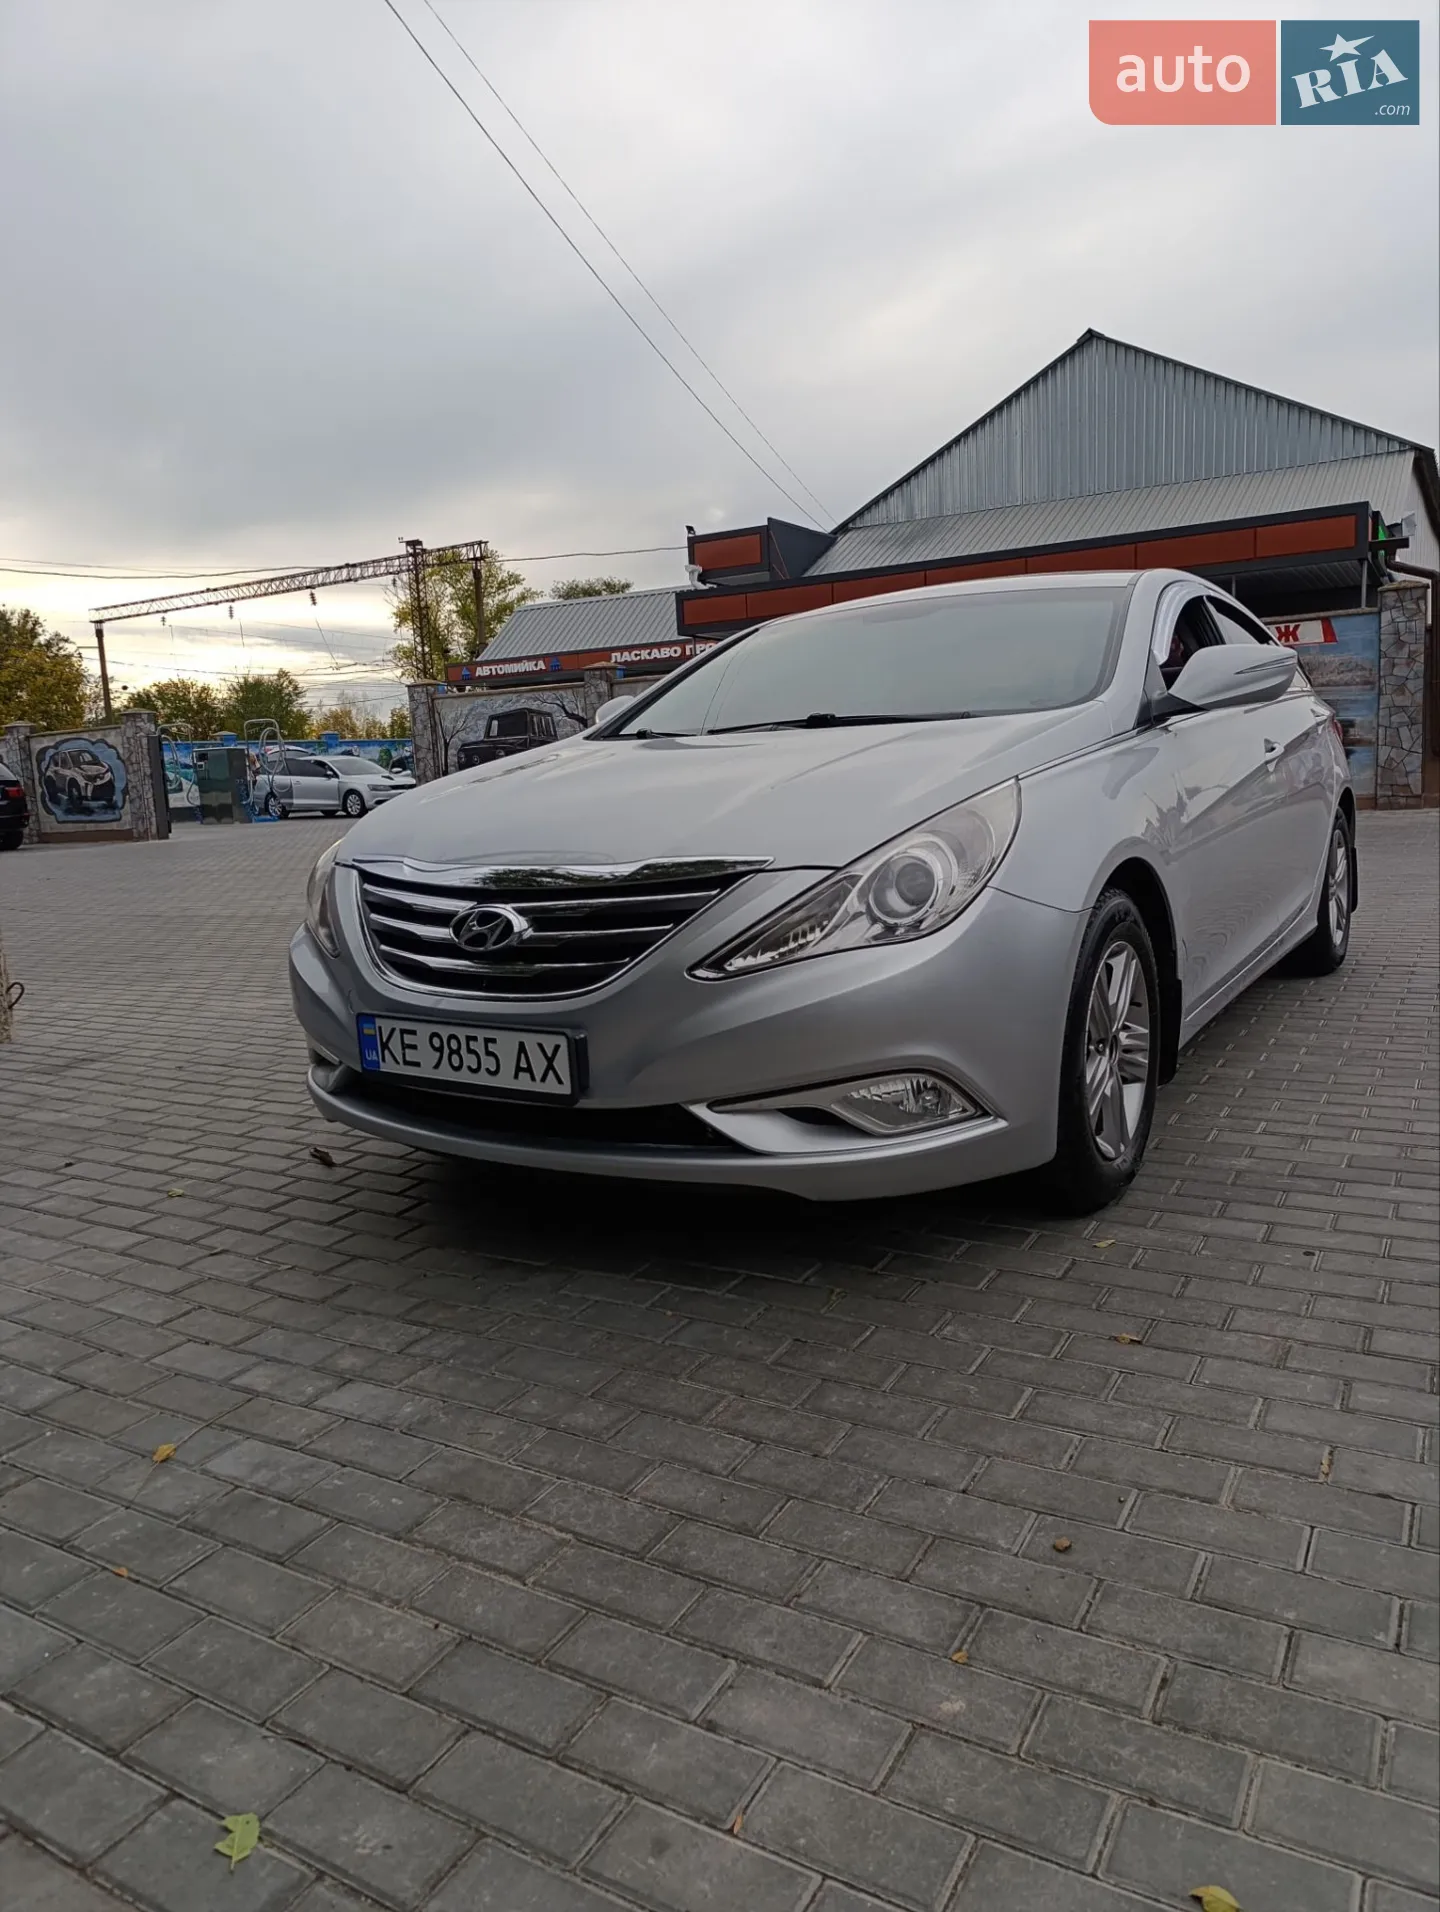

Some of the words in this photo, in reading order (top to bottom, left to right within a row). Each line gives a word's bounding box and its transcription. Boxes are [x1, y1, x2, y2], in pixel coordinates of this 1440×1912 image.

[611, 646, 682, 663] ЛАСКАВО
[475, 660, 546, 677] АВТОМИЙКА
[365, 1048, 378, 1061] UA
[378, 1025, 422, 1068] KE
[428, 1031, 501, 1077] 9855
[513, 1041, 565, 1086] AX
